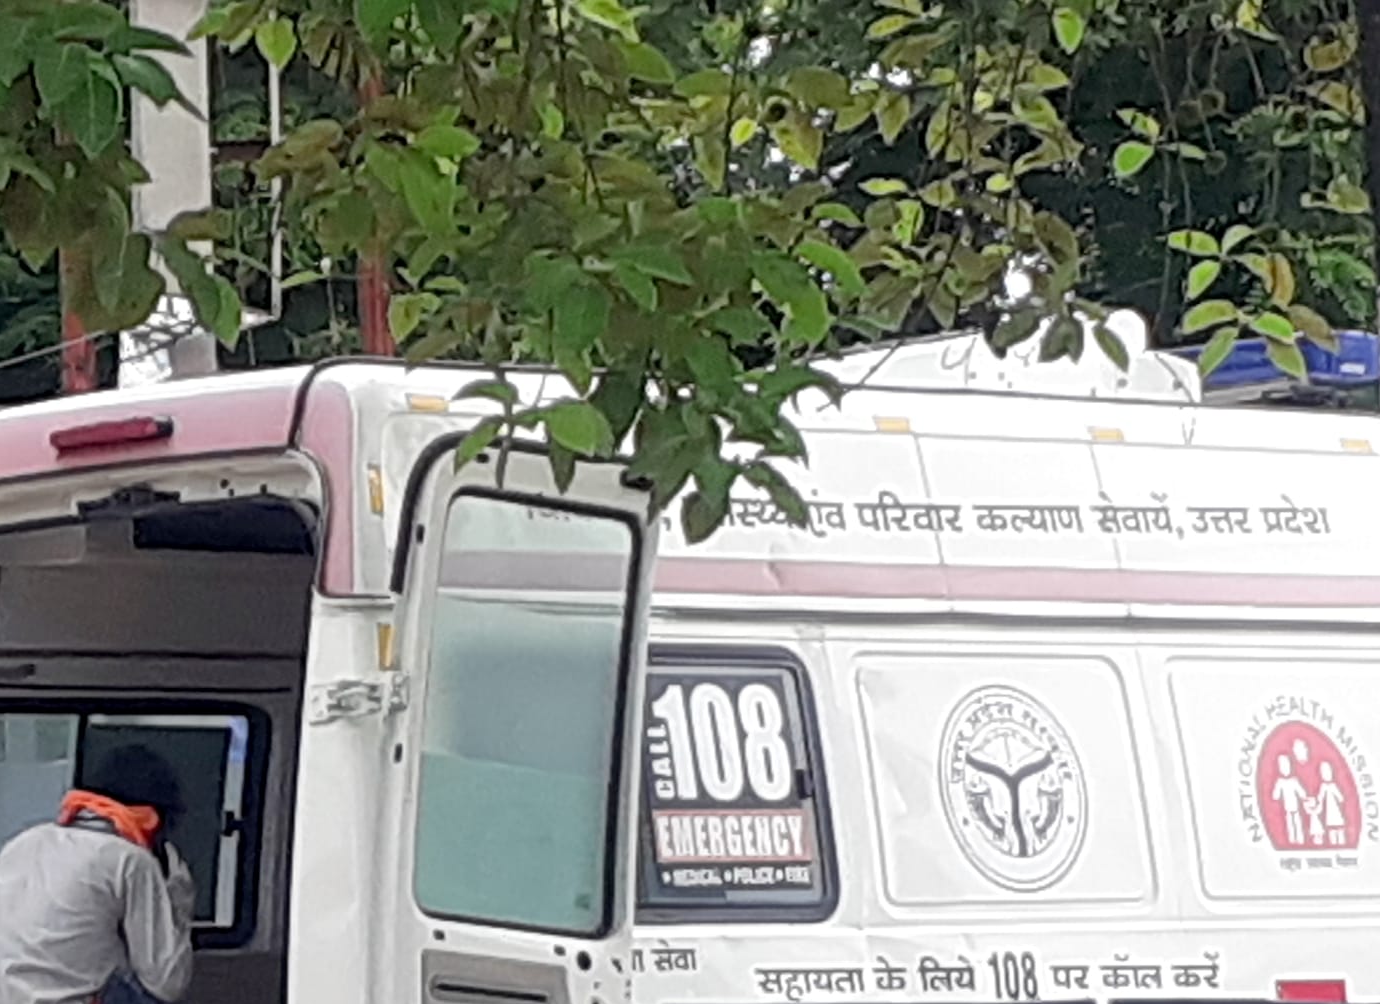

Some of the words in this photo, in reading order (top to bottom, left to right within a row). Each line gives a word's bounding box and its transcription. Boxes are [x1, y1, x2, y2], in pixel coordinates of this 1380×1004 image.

[854, 490, 963, 533] परिवार
[973, 503, 1084, 534] कल्याण
[1187, 505, 1253, 534] उत्तर
[1260, 493, 1332, 535] प्रदेश
[647, 724, 676, 799] CALL
[651, 682, 792, 801] 108
[1238, 713, 1267, 843] NATIONAL
[1264, 695, 1334, 731] HEALTH
[1336, 726, 1380, 842] MISSION
[655, 814, 804, 857] EMERGENCY
[650, 938, 698, 972] सेवा
[755, 966, 864, 1002] सहायता
[873, 955, 907, 992] के
[918, 957, 976, 993] लिये
[989, 951, 1039, 1000] 108
[1051, 965, 1089, 991] पर
[1102, 954, 1163, 990] कॉल
[1172, 953, 1222, 991] करें
